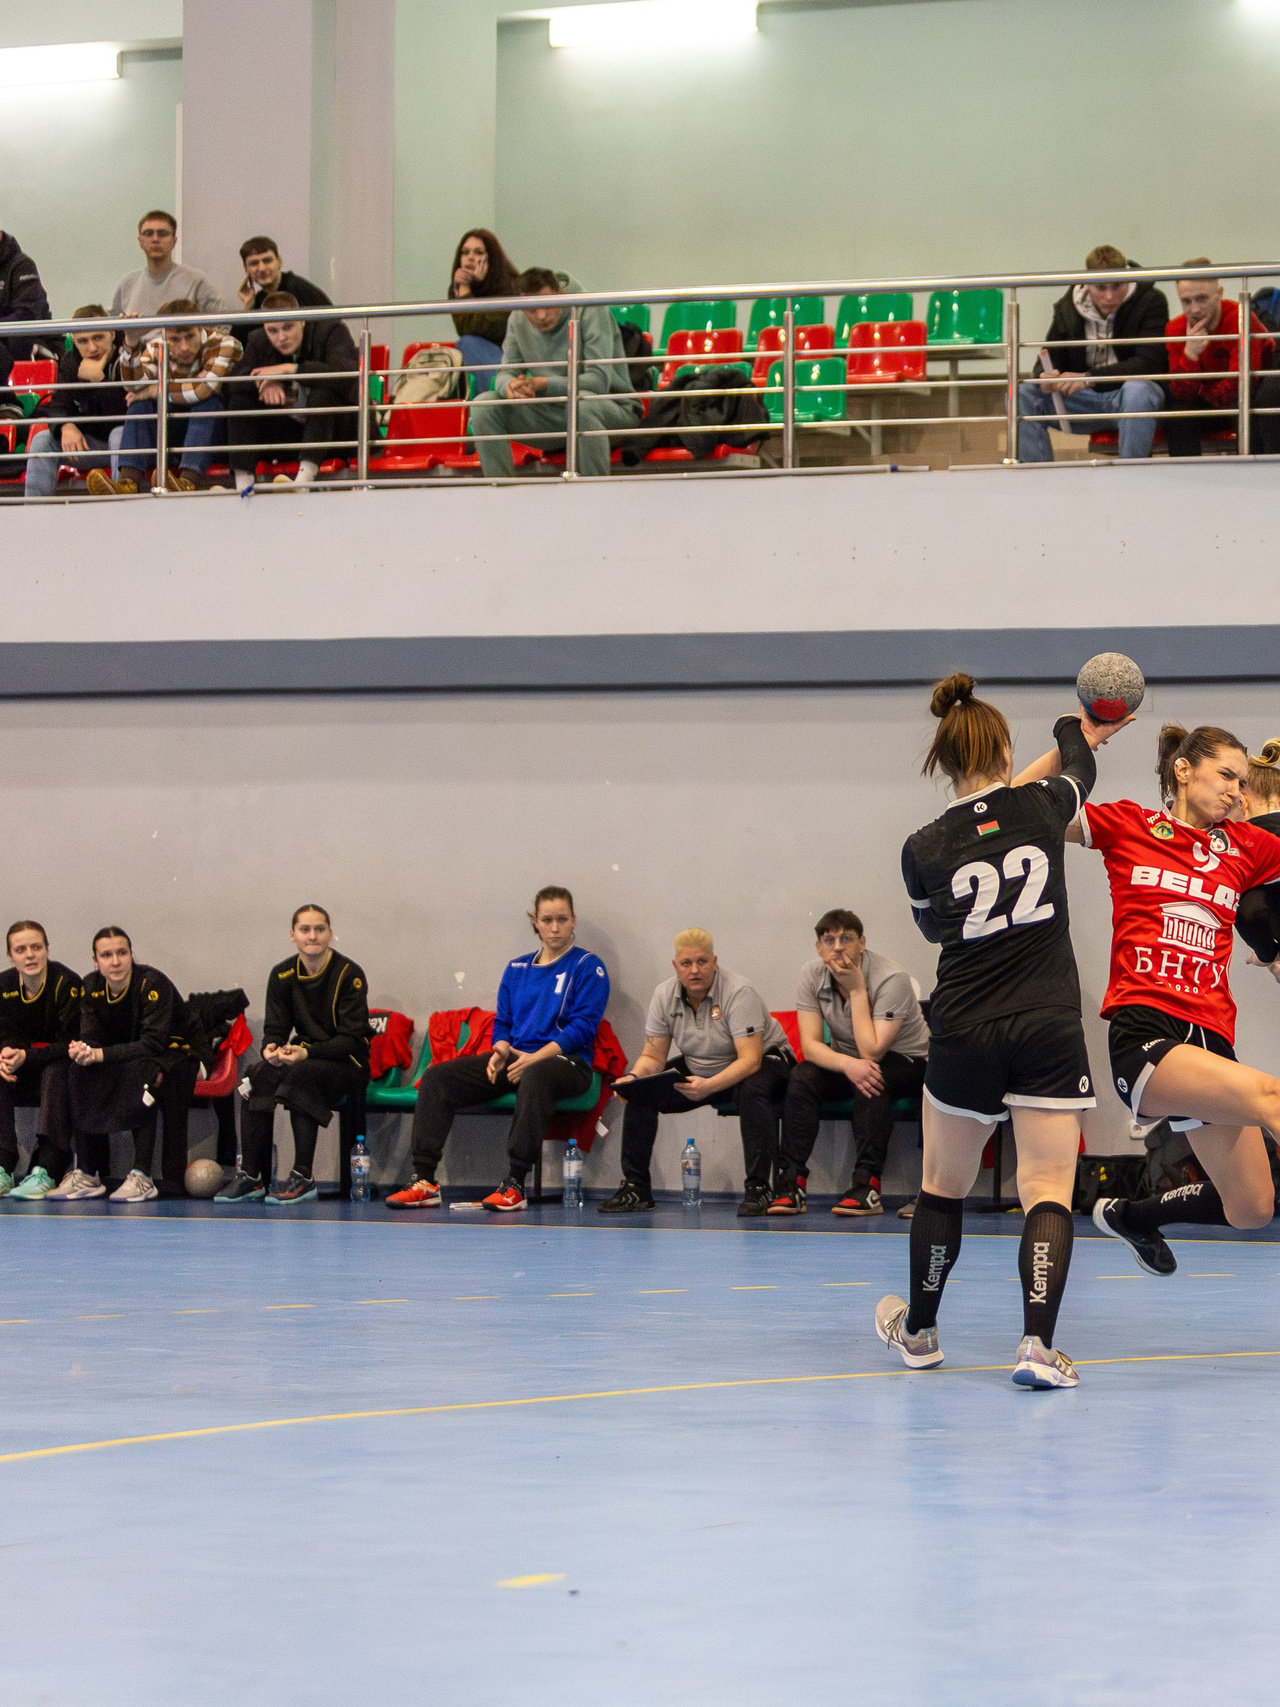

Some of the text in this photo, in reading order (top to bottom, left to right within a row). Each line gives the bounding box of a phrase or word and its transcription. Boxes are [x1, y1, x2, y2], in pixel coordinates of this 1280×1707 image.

[952, 845, 1056, 940] 22
[554, 971, 567, 994] 1
[1134, 946, 1225, 988] БНТУ
[922, 1244, 951, 1292] Kempa
[1029, 1241, 1054, 1304] Kempa
